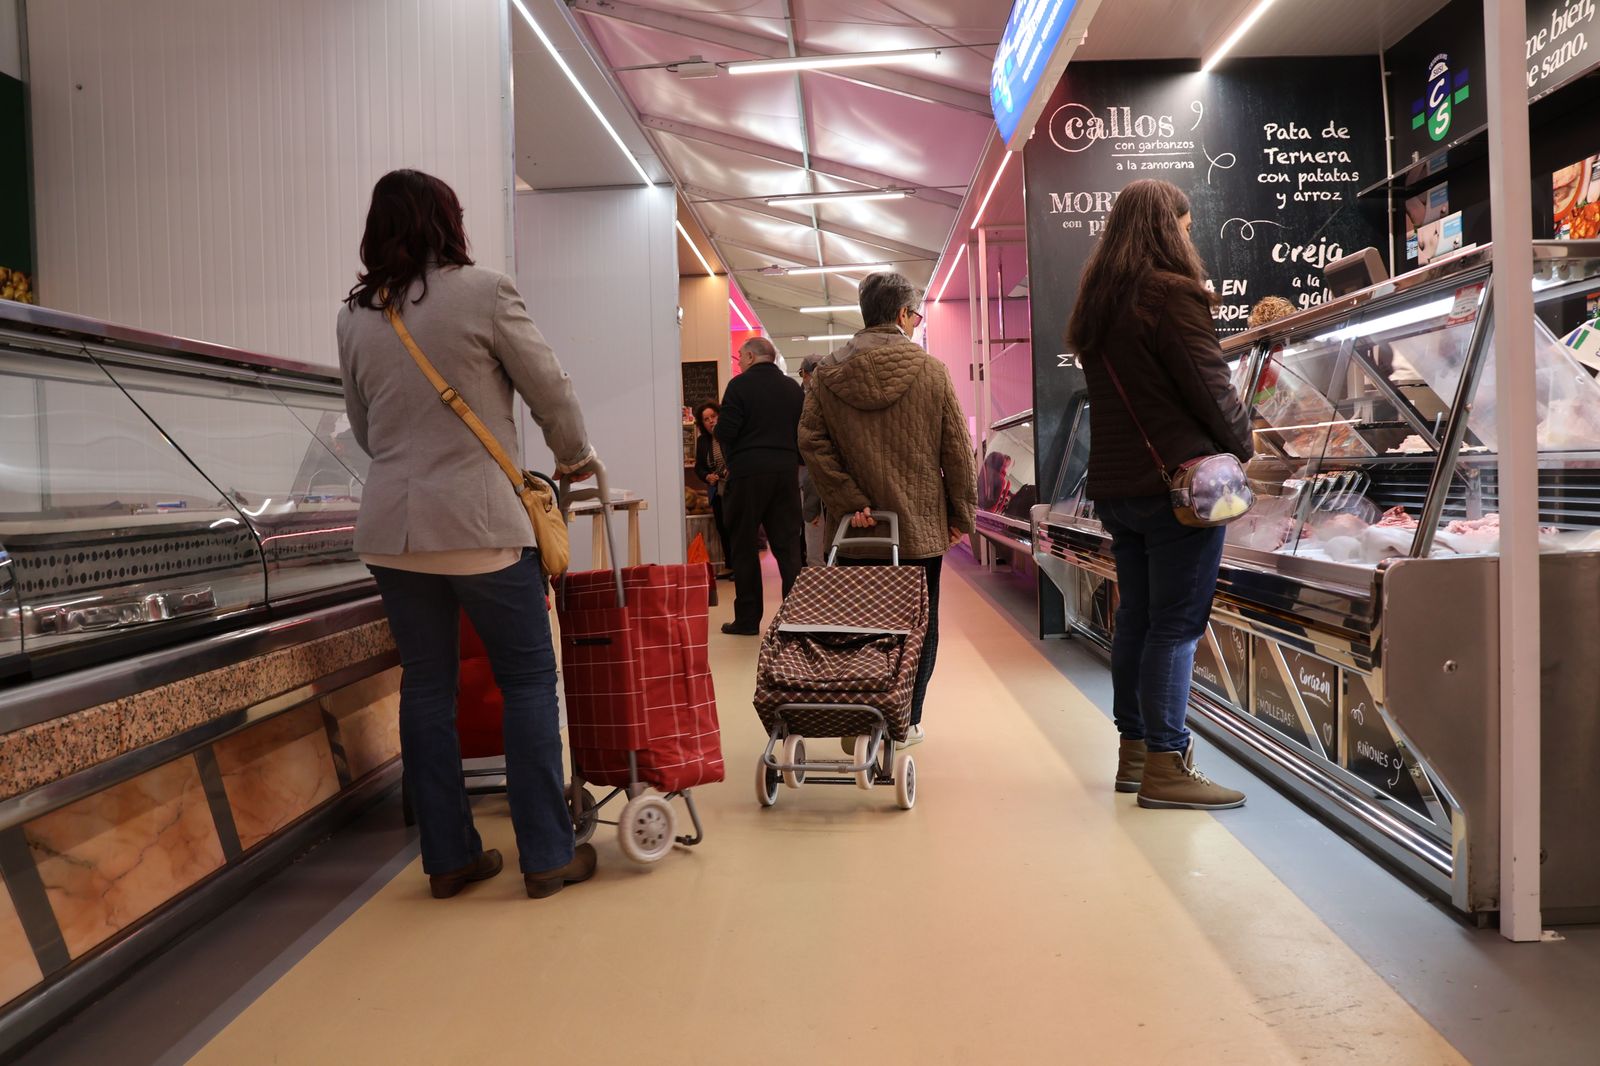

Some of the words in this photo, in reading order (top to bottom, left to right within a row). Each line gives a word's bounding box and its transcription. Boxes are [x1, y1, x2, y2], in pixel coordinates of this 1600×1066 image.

[1549, 0, 1596, 43] bien,
[1540, 32, 1589, 80] sano.
[1264, 121, 1310, 140] Pata
[1321, 120, 1351, 139] de
[1115, 141, 1135, 150] con
[1138, 139, 1195, 153] garbanzos
[1264, 147, 1352, 165] Ternera
[1116, 161, 1124, 170] a
[1127, 158, 1138, 170] la
[1140, 159, 1195, 171] zamorana
[1257, 171, 1291, 183] con
[1298, 168, 1360, 184] patatas
[1048, 191, 1121, 214] MOR
[1276, 191, 1287, 210] y
[1294, 190, 1343, 202] arroz
[1062, 220, 1082, 229] con
[1088, 215, 1108, 237] pi
[1222, 279, 1248, 297] EN
[1292, 276, 1301, 288] a
[1306, 274, 1320, 288] la
[1299, 666, 1332, 702] Corazón
[1259, 697, 1292, 727] MOLLEJAS
[1357, 740, 1389, 768] RIÑONES
